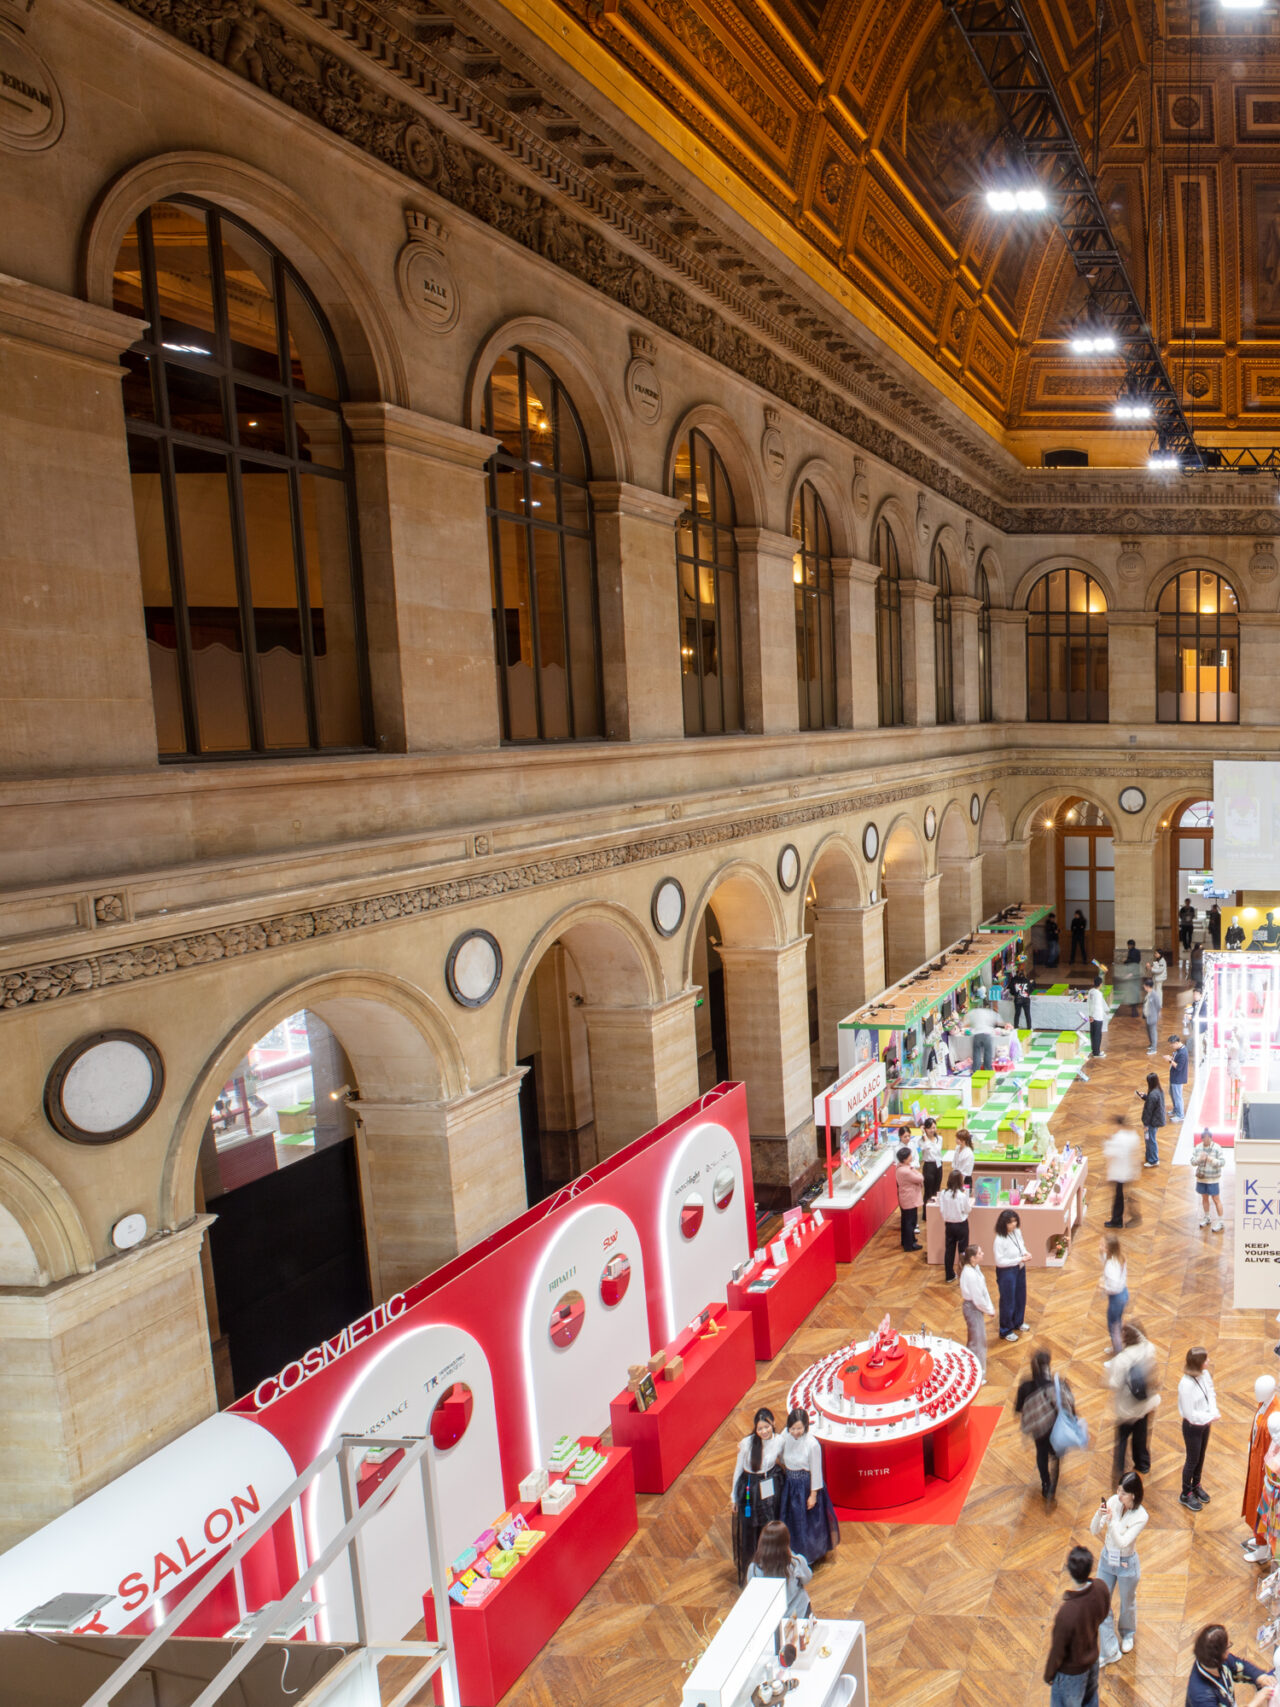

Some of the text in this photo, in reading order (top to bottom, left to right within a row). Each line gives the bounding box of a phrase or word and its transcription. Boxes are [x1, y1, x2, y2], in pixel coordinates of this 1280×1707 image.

[254, 1292, 407, 1408] COSMETIC
[858, 1467, 890, 1477] TIRTIR
[118, 1484, 261, 1612] SALON
